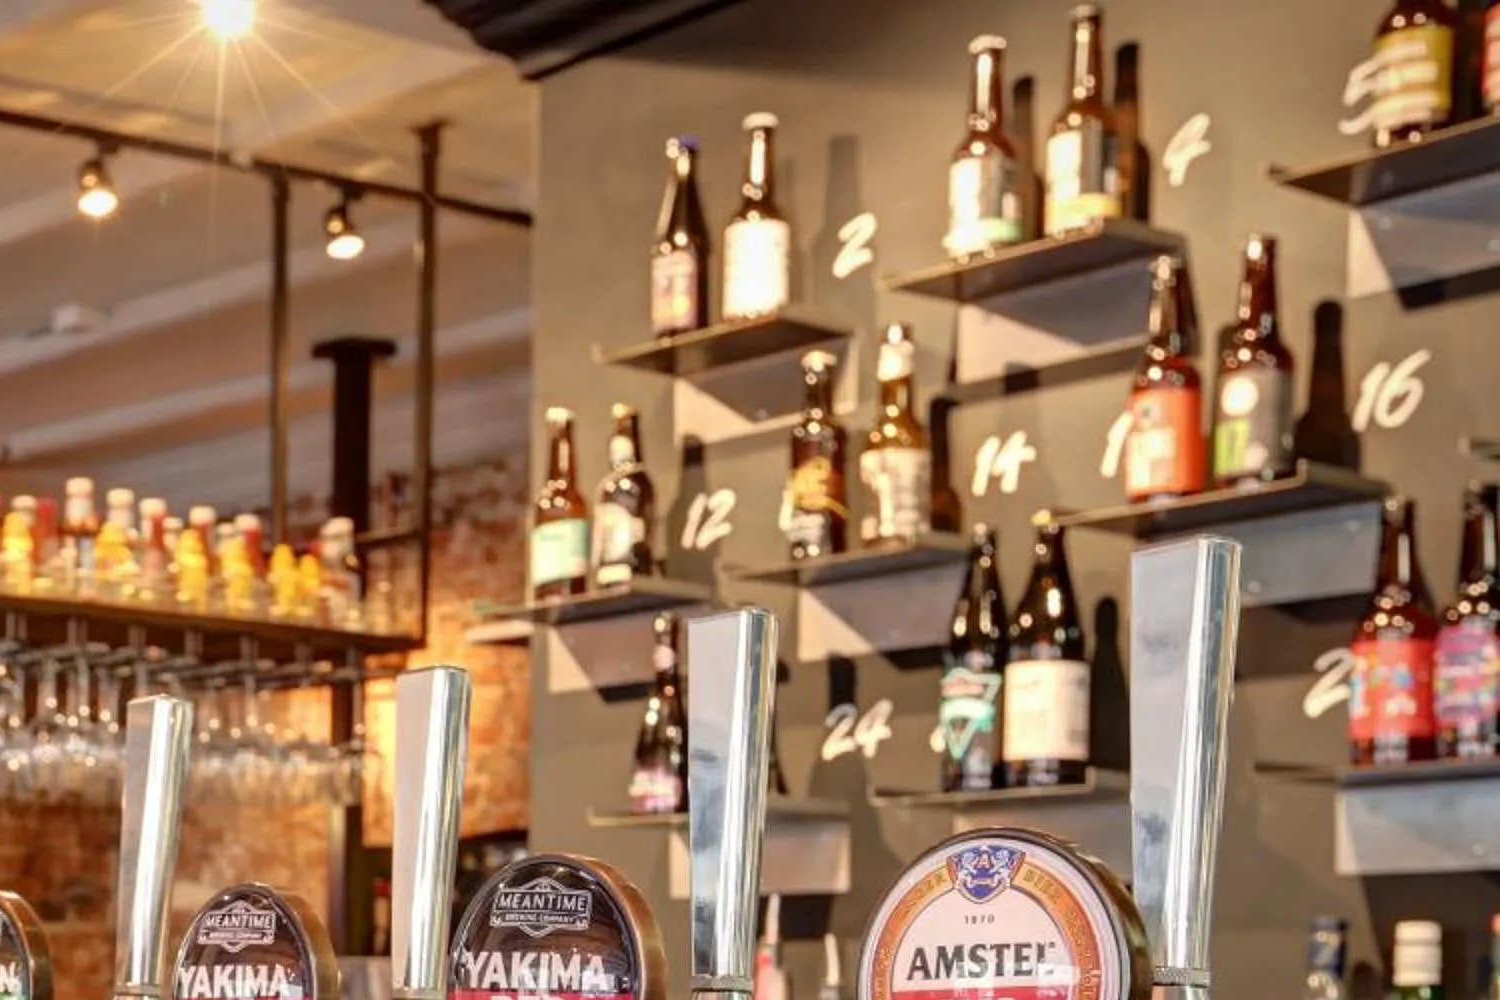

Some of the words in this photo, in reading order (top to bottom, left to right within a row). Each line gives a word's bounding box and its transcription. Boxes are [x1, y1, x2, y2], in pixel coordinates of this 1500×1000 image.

[832, 212, 878, 279] 2
[1353, 349, 1431, 432] 16
[972, 431, 1037, 497] 14
[681, 488, 738, 550] 12
[821, 698, 894, 761] 24
[206, 914, 272, 929] MEANTIME
[497, 892, 588, 912] MEANTIME
[964, 914, 996, 926] 1870
[180, 963, 289, 999] YAKIMA
[466, 950, 609, 991] YAKIMA
